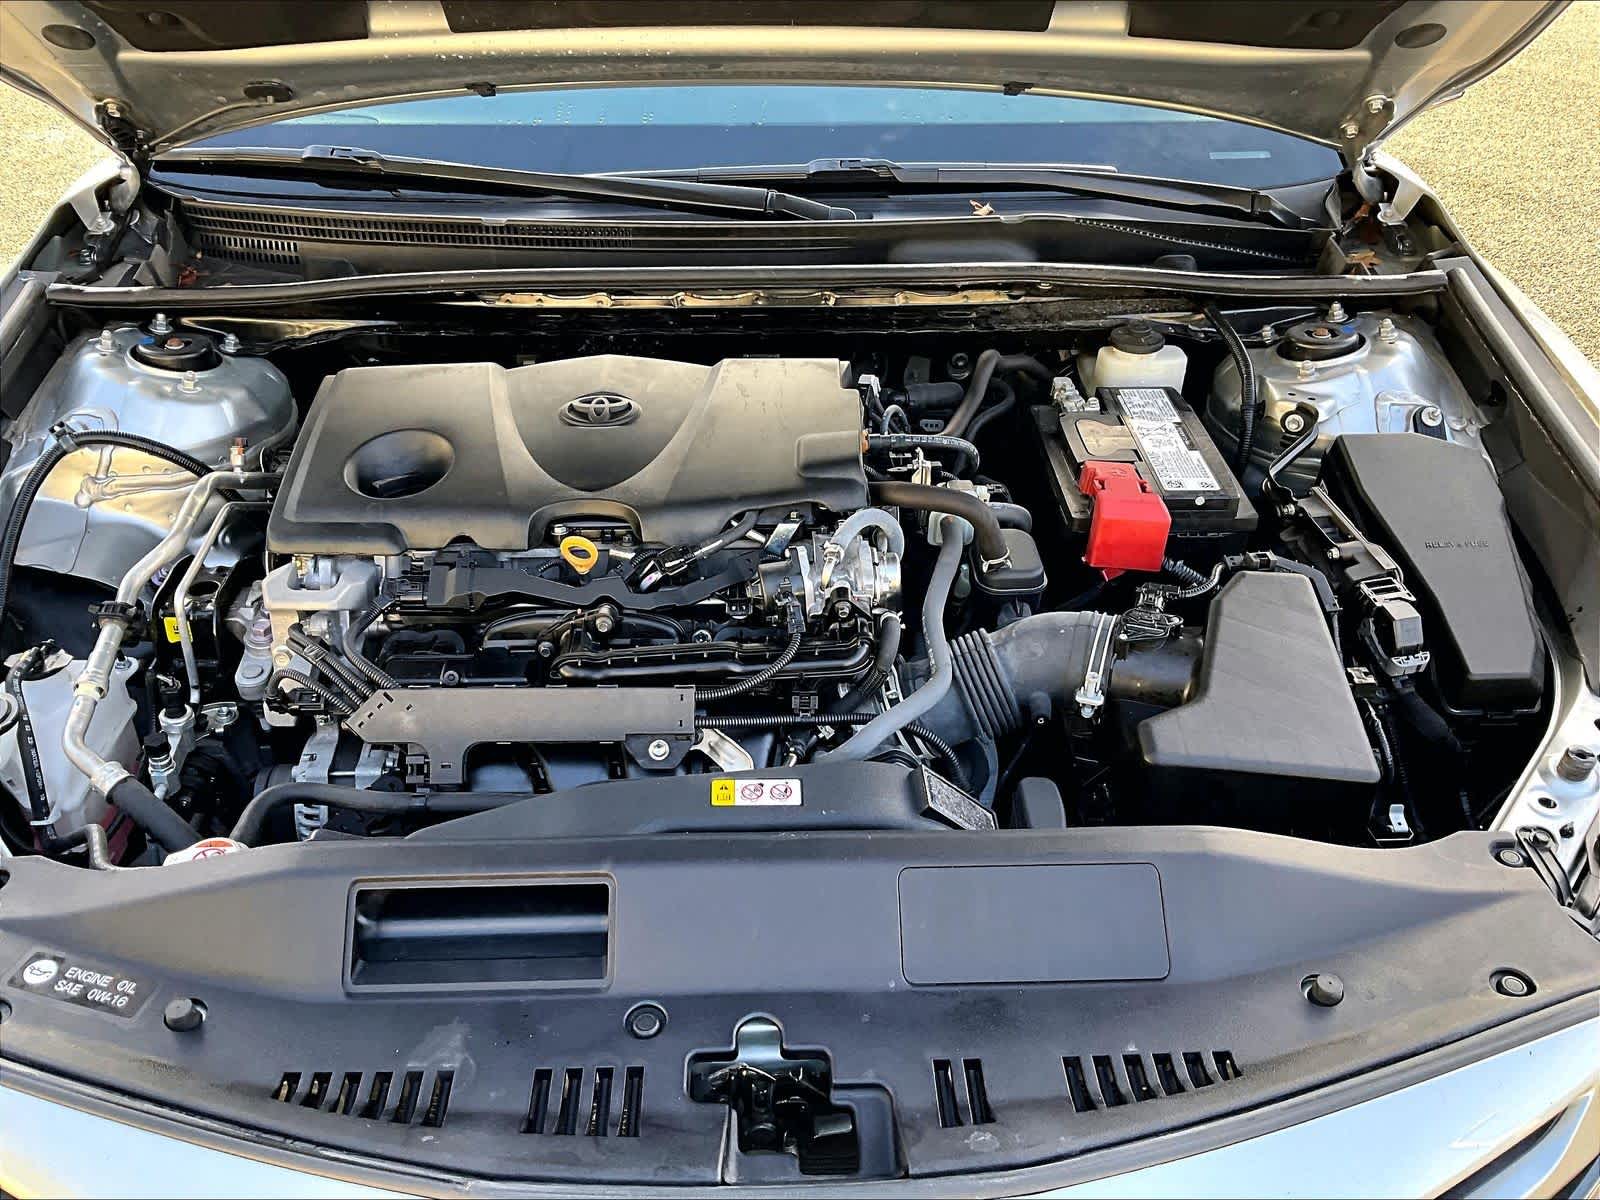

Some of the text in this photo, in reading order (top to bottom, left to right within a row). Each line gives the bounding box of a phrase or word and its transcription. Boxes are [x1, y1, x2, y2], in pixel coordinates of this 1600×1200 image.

[54, 980, 129, 1007] SAE 0W-16
[65, 966, 137, 995] ENGINE OIL
